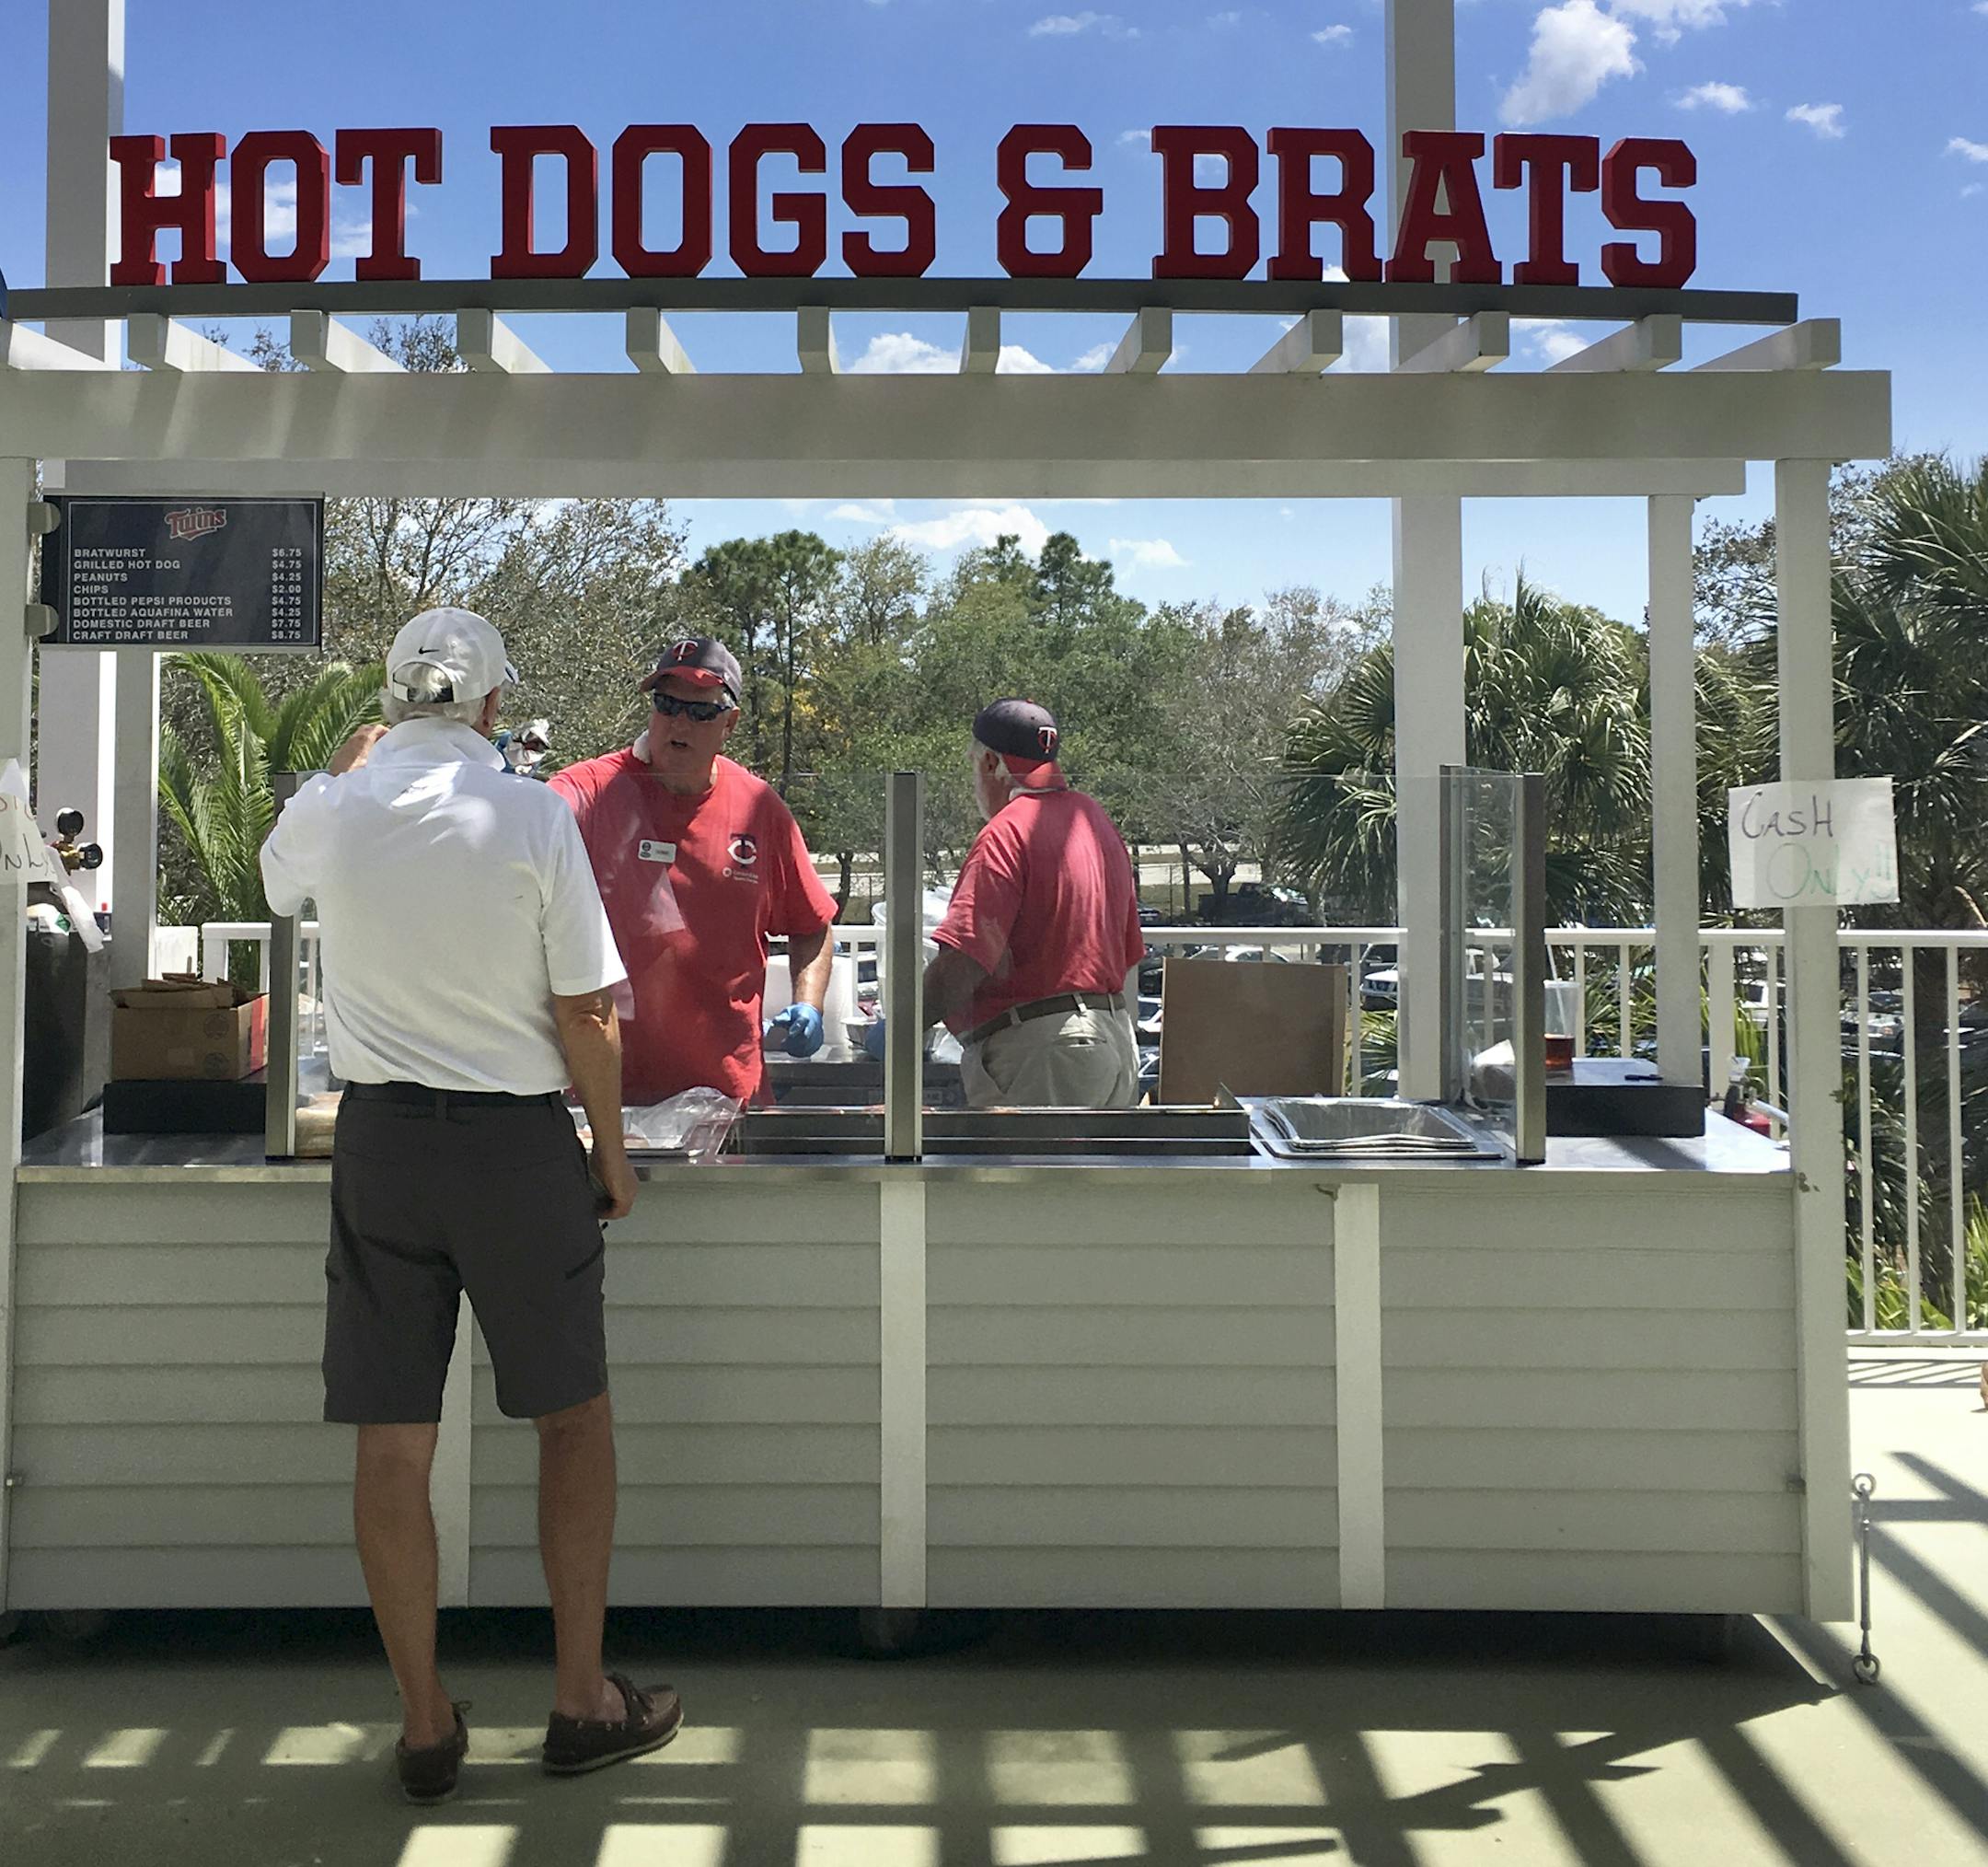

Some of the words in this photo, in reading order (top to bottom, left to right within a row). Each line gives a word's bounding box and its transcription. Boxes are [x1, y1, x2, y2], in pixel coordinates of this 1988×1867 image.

[110, 128, 443, 286] HOT
[490, 122, 936, 280] DOGS
[997, 123, 1104, 279] &
[1151, 125, 1696, 289] BRATS
[164, 506, 227, 541] Twins
[74, 548, 145, 558] BRATWURST
[272, 548, 302, 557] $6.75
[74, 560, 124, 570] GRILLED
[128, 560, 152, 570] HOT
[155, 560, 181, 570] DOG
[272, 560, 302, 569] $4.75
[74, 573, 128, 583] PEANUTS
[272, 573, 302, 582] $4.25
[74, 585, 110, 595] CHIPS
[272, 585, 302, 594] $2.00
[74, 597, 127, 606] BOTTLED
[131, 597, 165, 606] PEPSI
[168, 597, 232, 606] PRODUCTS
[272, 597, 302, 605] $4.75
[74, 608, 127, 618] BOTTLED
[130, 608, 191, 618] AQUAFINA
[193, 608, 234, 618] WATER
[272, 608, 302, 617] $4.25
[74, 619, 133, 629] DOMESTIC
[137, 619, 175, 629] DRAFT
[179, 619, 211, 629] BEER
[272, 619, 302, 628] $7.75
[73, 631, 111, 641] CRAFT
[115, 631, 154, 641] DRAFT
[156, 631, 189, 641] BEER
[1741, 789, 1833, 839] CASH
